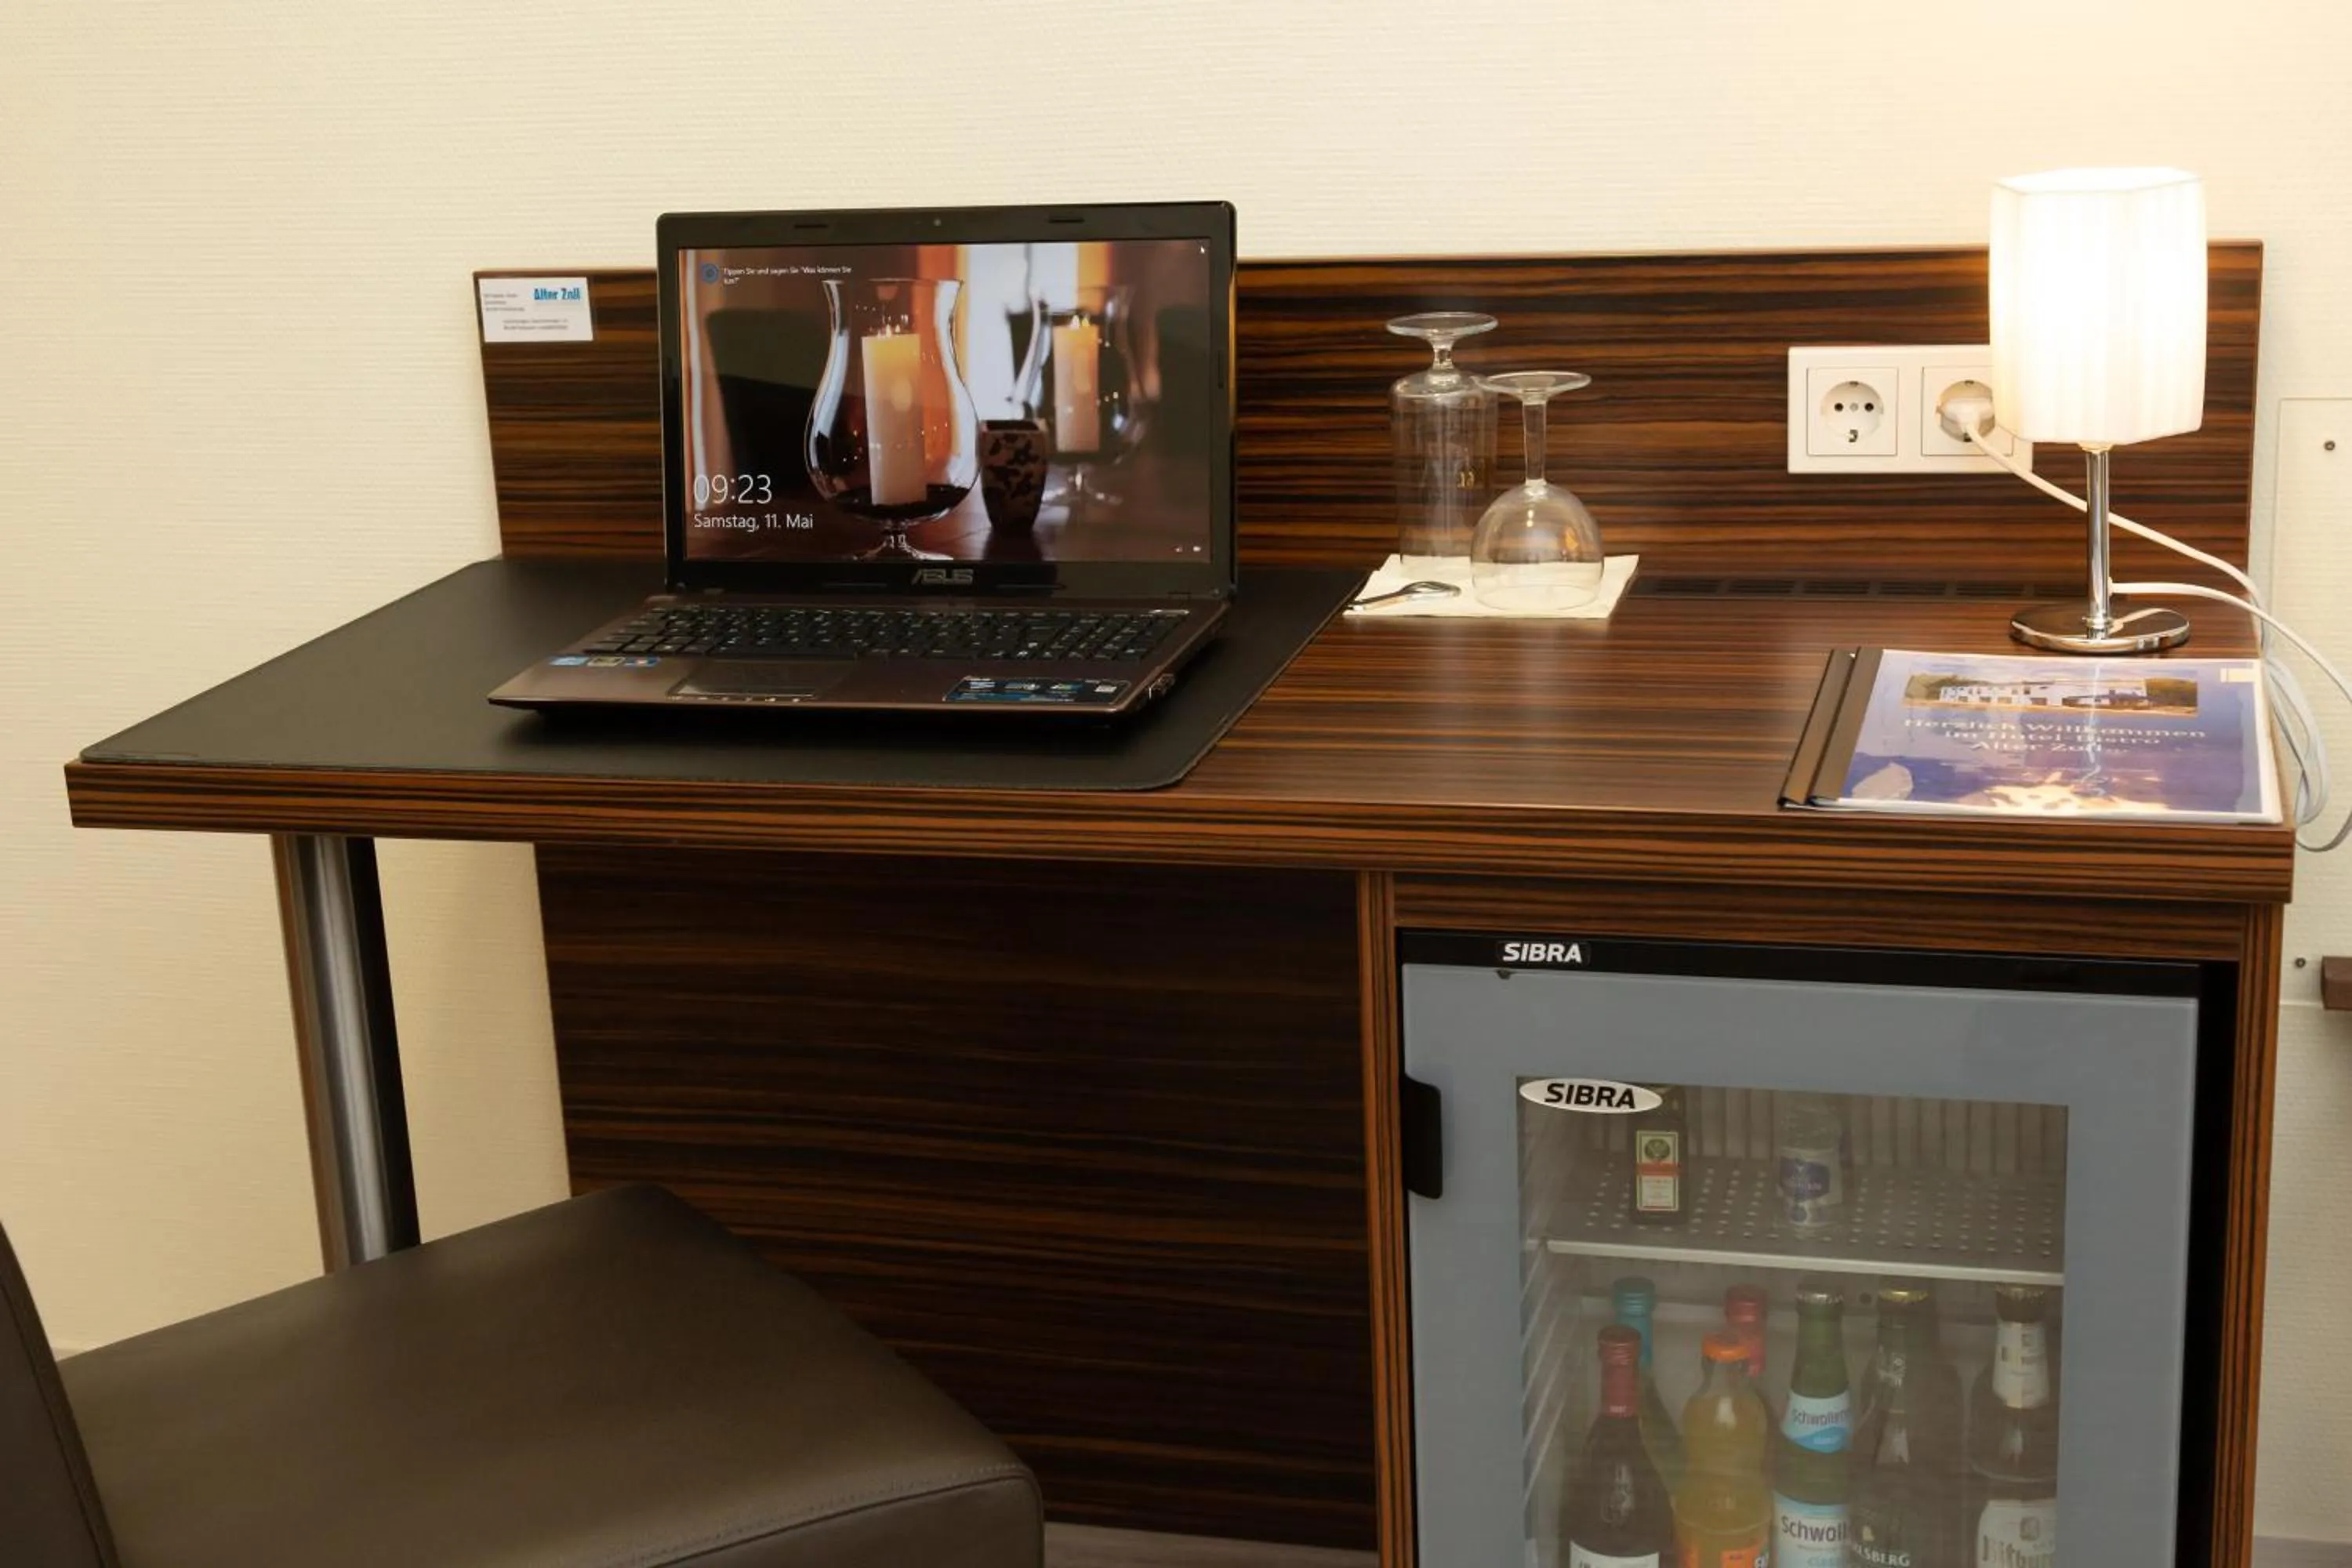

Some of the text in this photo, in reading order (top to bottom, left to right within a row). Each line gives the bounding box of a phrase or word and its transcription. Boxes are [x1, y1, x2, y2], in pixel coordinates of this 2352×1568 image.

[534, 287, 581, 300] Alter Zoll
[693, 474, 773, 504] 09:23
[694, 514, 813, 533] Samstag, 11. Mai
[912, 568, 974, 585] ASUS
[1904, 719, 2205, 738] Herzlich Willkommen
[1969, 741, 2102, 753] Alter Zoll
[1503, 942, 1582, 963] SIBRA
[1544, 1083, 1635, 1109] SIBRA
